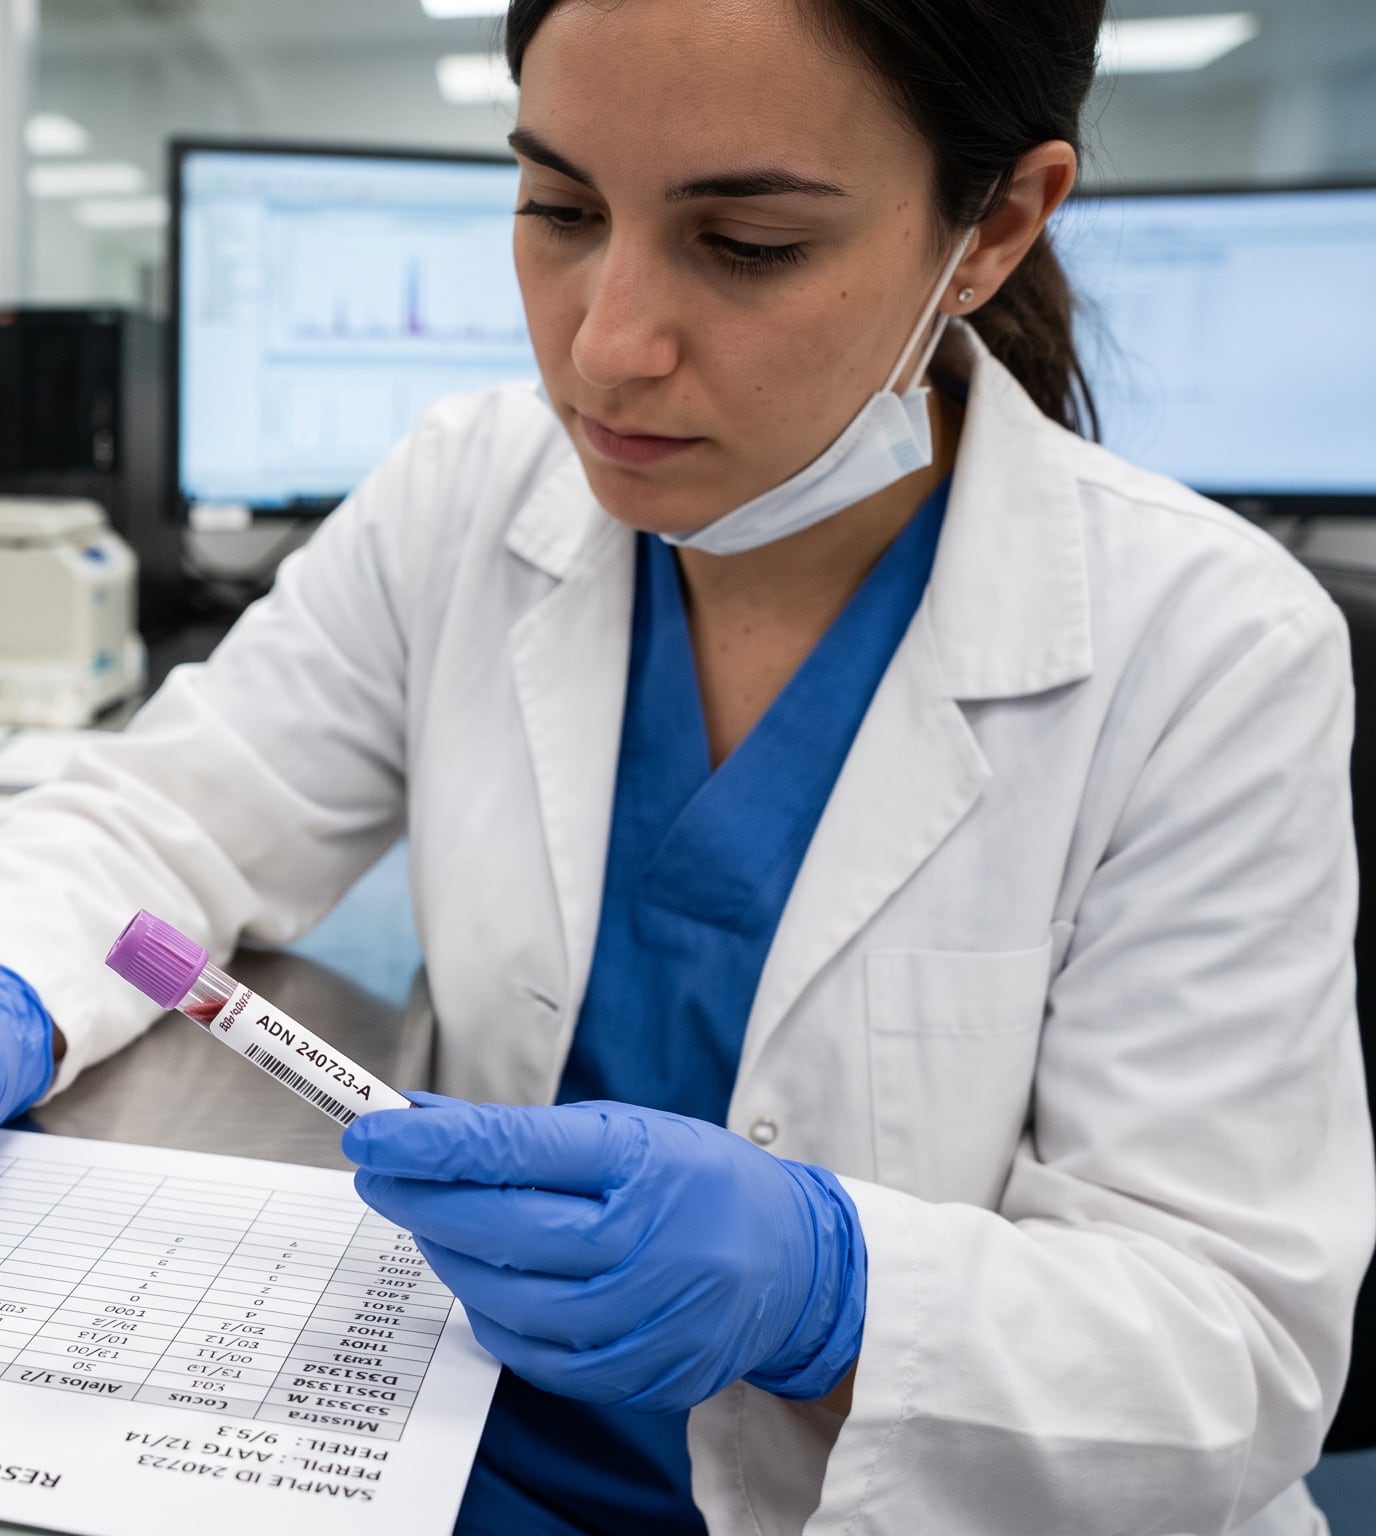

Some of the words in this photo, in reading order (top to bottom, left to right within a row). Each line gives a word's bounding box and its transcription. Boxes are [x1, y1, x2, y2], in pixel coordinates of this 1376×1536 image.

[256, 1015, 296, 1046] ADN
[295, 1041, 372, 1101] 240723-A
[19, 1370, 58, 1384] 1/2
[125, 1430, 191, 1451] 12/14
[203, 1442, 273, 1463] AATG
[137, 1453, 227, 1478] 240723
[235, 1469, 262, 1484] ID
[269, 1474, 376, 1502] SAMPLE
